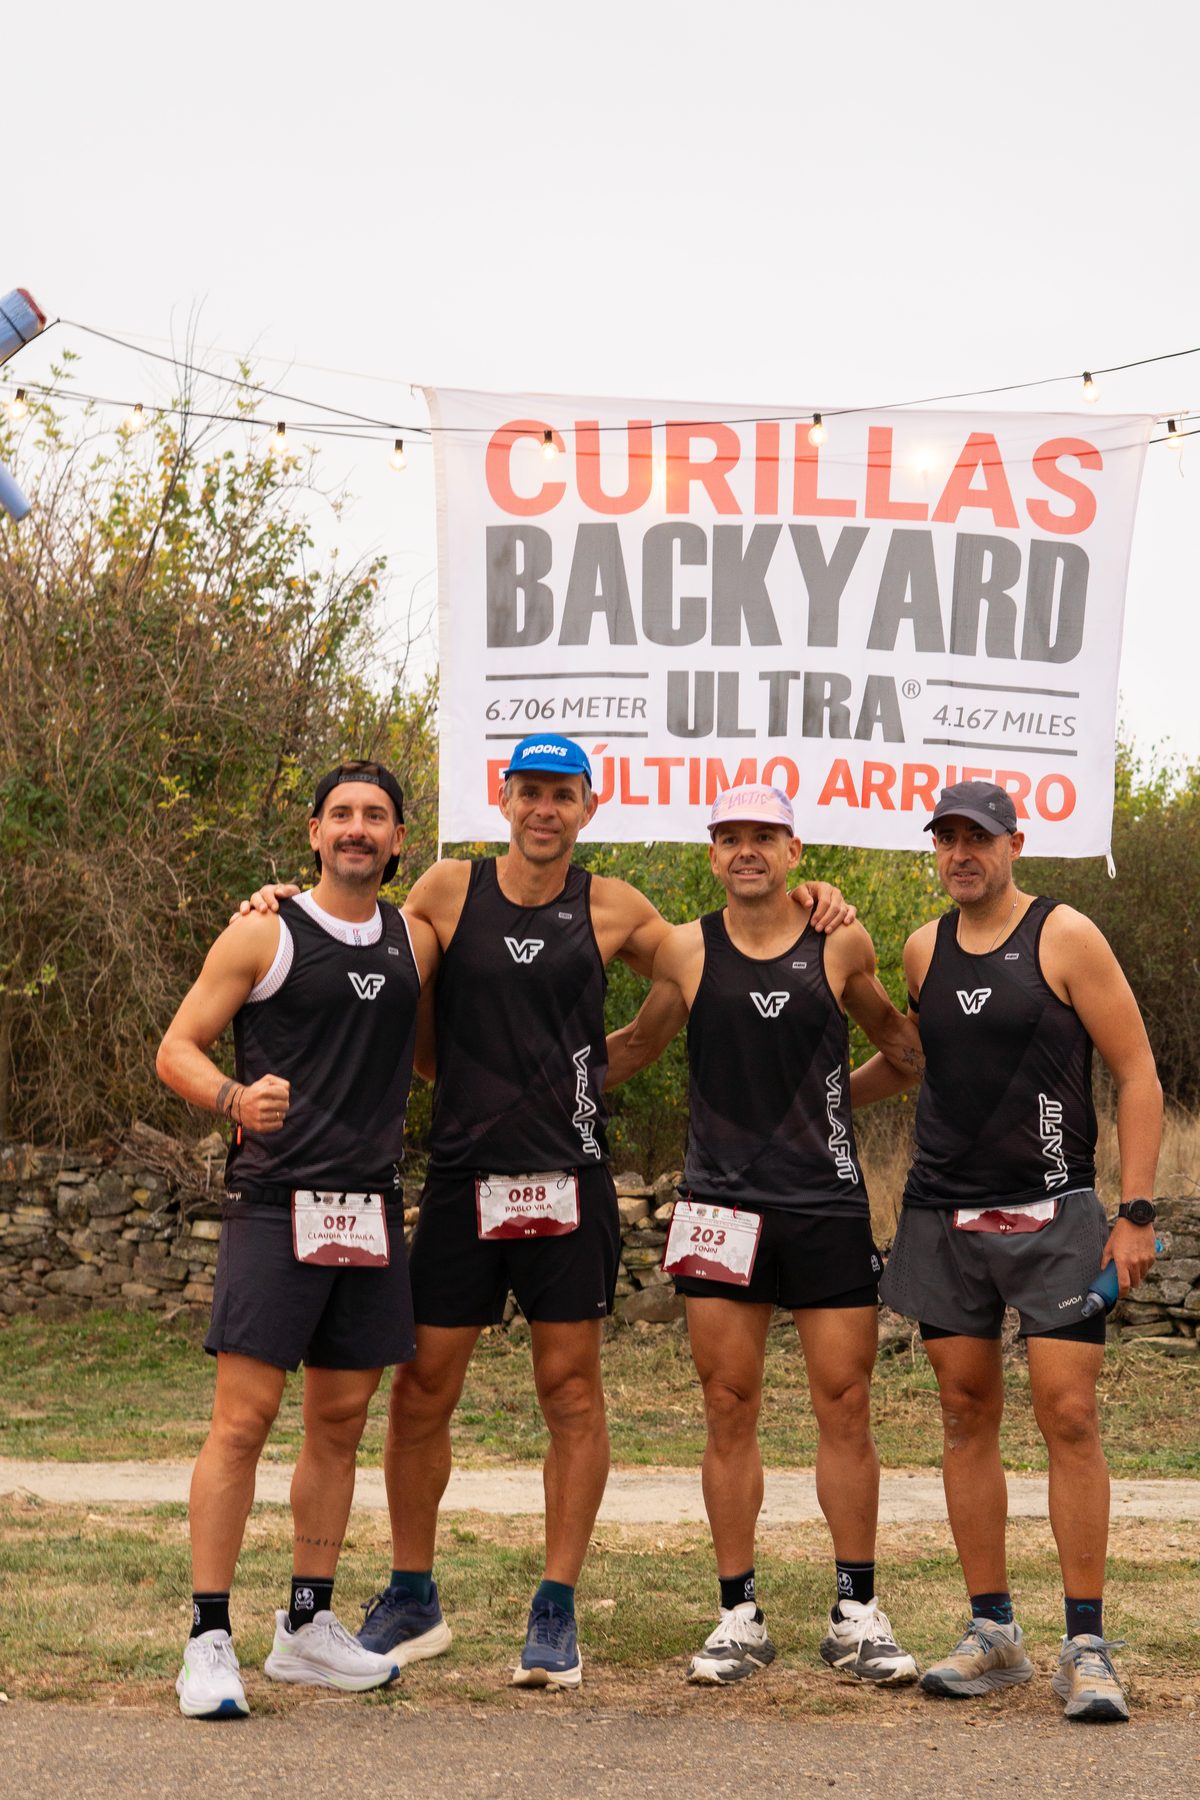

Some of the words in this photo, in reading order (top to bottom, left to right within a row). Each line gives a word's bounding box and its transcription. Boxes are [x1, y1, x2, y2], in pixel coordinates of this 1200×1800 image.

[485, 419, 1104, 534] CURILLAS
[486, 522, 1090, 664] BACKYARD
[485, 698, 556, 721] 6.706
[561, 696, 647, 719] METER
[932, 704, 999, 731] 4.167
[1002, 710, 1077, 738] MILES
[521, 744, 568, 759] BROOKS
[595, 743, 800, 806] ÚLTIMO
[503, 935, 545, 965] VF
[347, 971, 386, 1000] VF
[749, 991, 790, 1019] VF
[956, 987, 992, 1015] VF
[572, 1044, 602, 1160] VILAFIT
[825, 1063, 859, 1185] VILAFIT
[508, 1185, 547, 1203] 088
[534, 1203, 553, 1212] VILA
[323, 1215, 357, 1231] 087
[690, 1225, 727, 1246] 203
